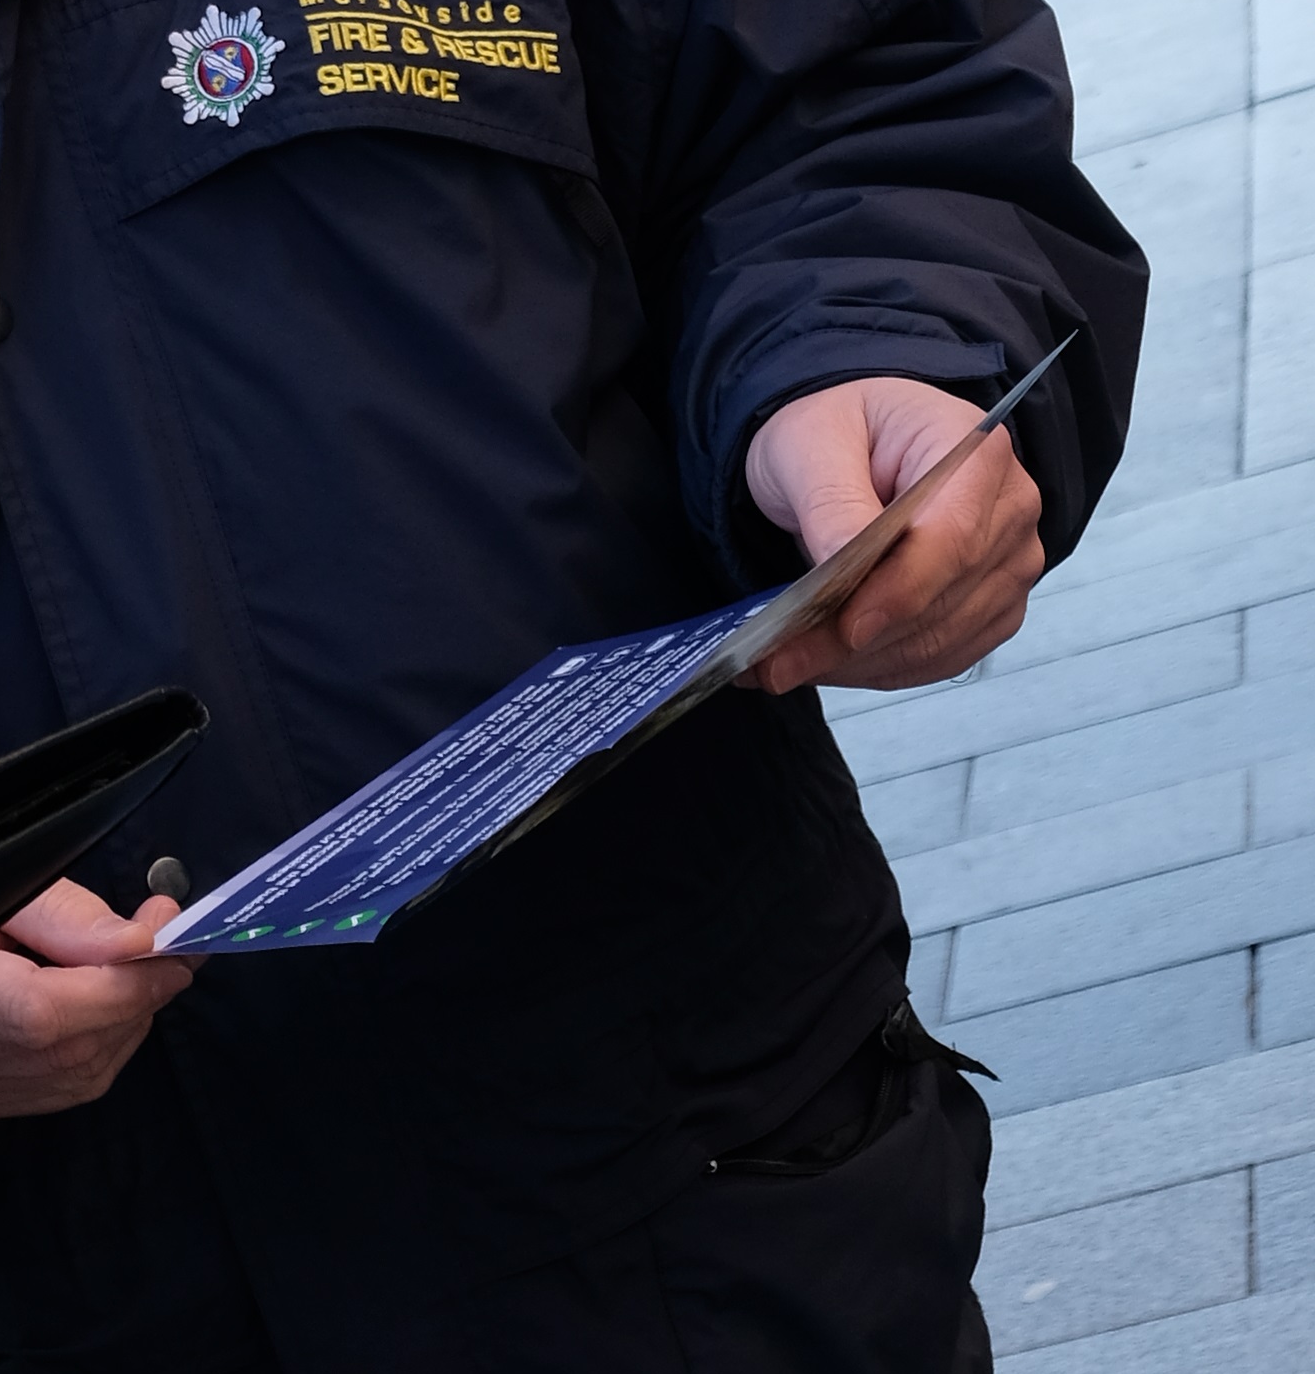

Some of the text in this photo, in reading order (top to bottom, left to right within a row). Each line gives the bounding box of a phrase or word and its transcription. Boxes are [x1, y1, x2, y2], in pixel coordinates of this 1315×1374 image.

[307, 22, 562, 74] FIRE & RESCUE
[316, 62, 460, 102] SERVICE
